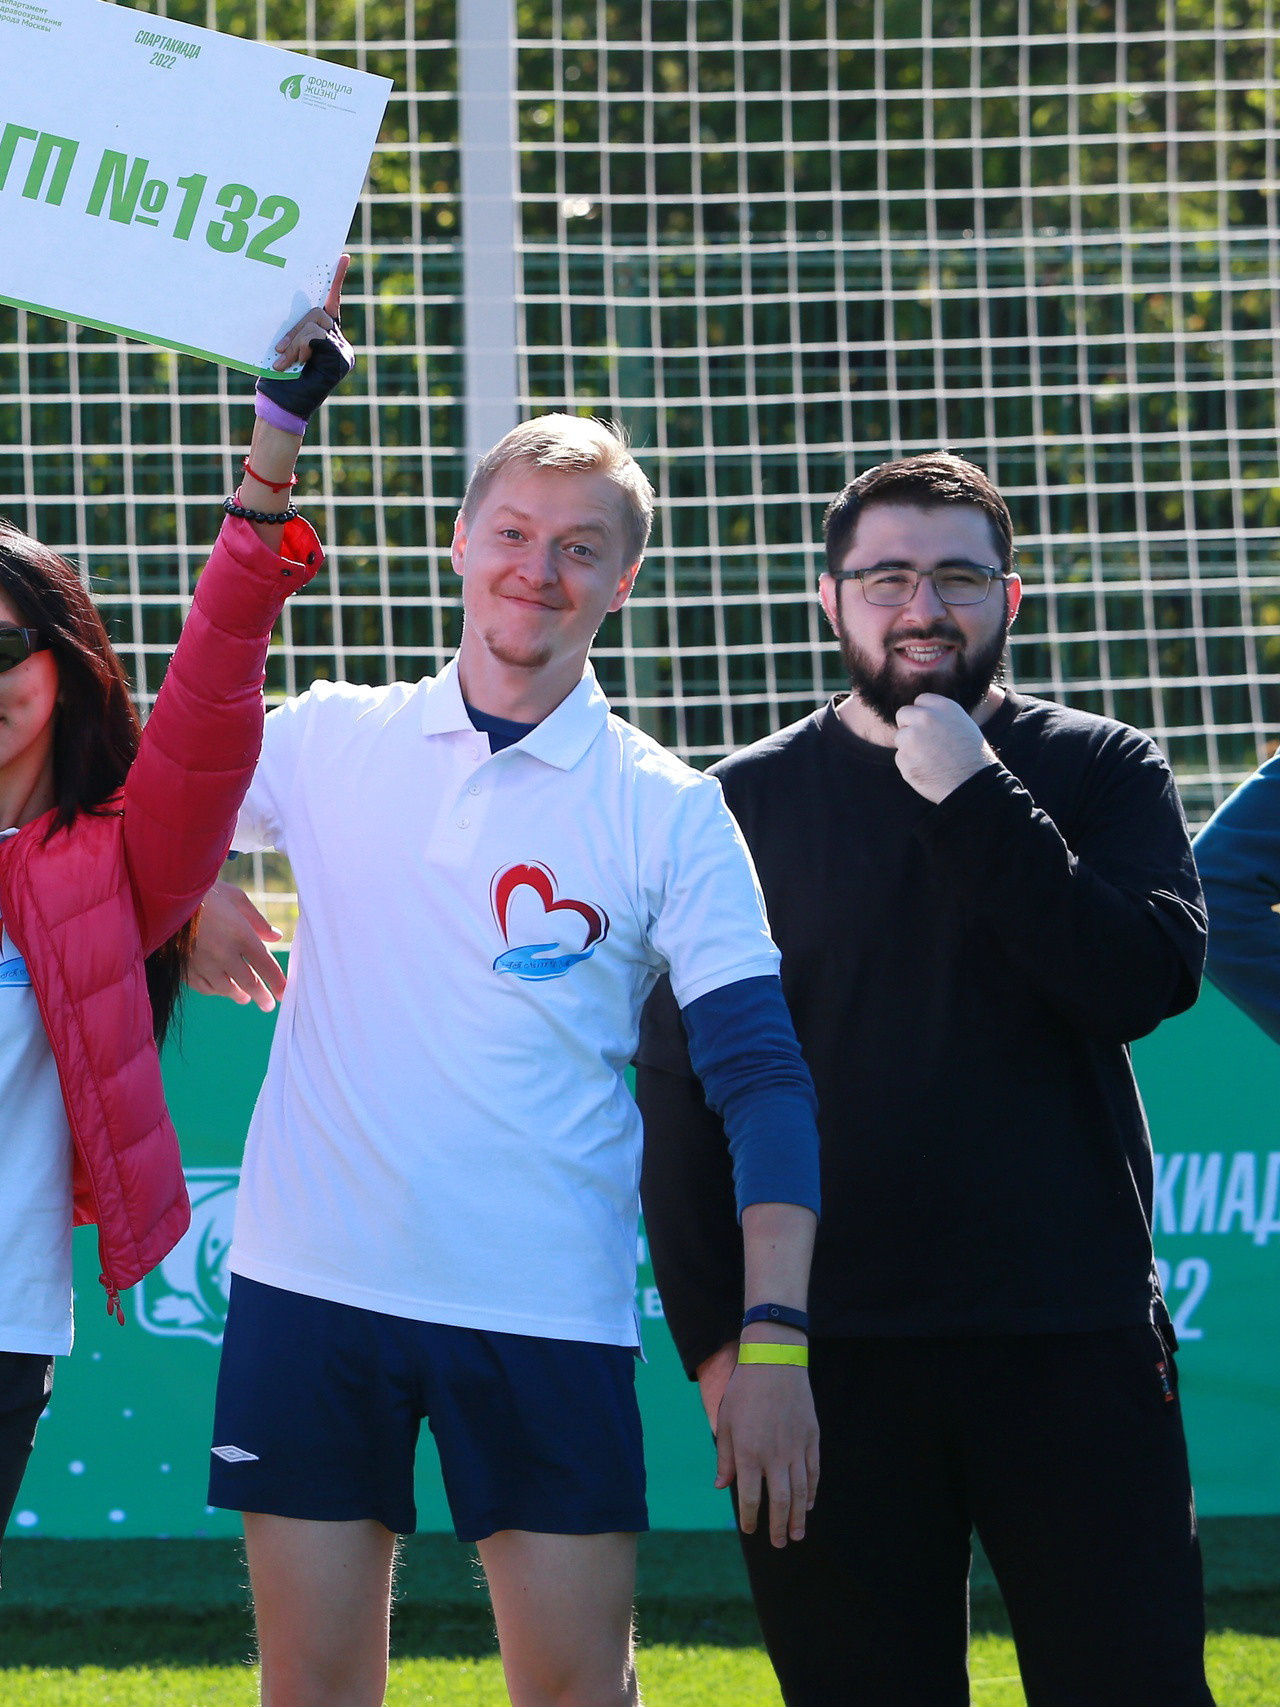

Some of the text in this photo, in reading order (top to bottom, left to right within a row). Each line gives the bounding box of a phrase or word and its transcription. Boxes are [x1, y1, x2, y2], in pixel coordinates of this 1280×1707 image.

[21, 19, 51, 32] Москвы
[134, 29, 202, 60] СПАРТАКИАДА
[149, 51, 177, 70] 2022
[304, 85, 337, 101] жизни
[85, 148, 301, 269] №132
